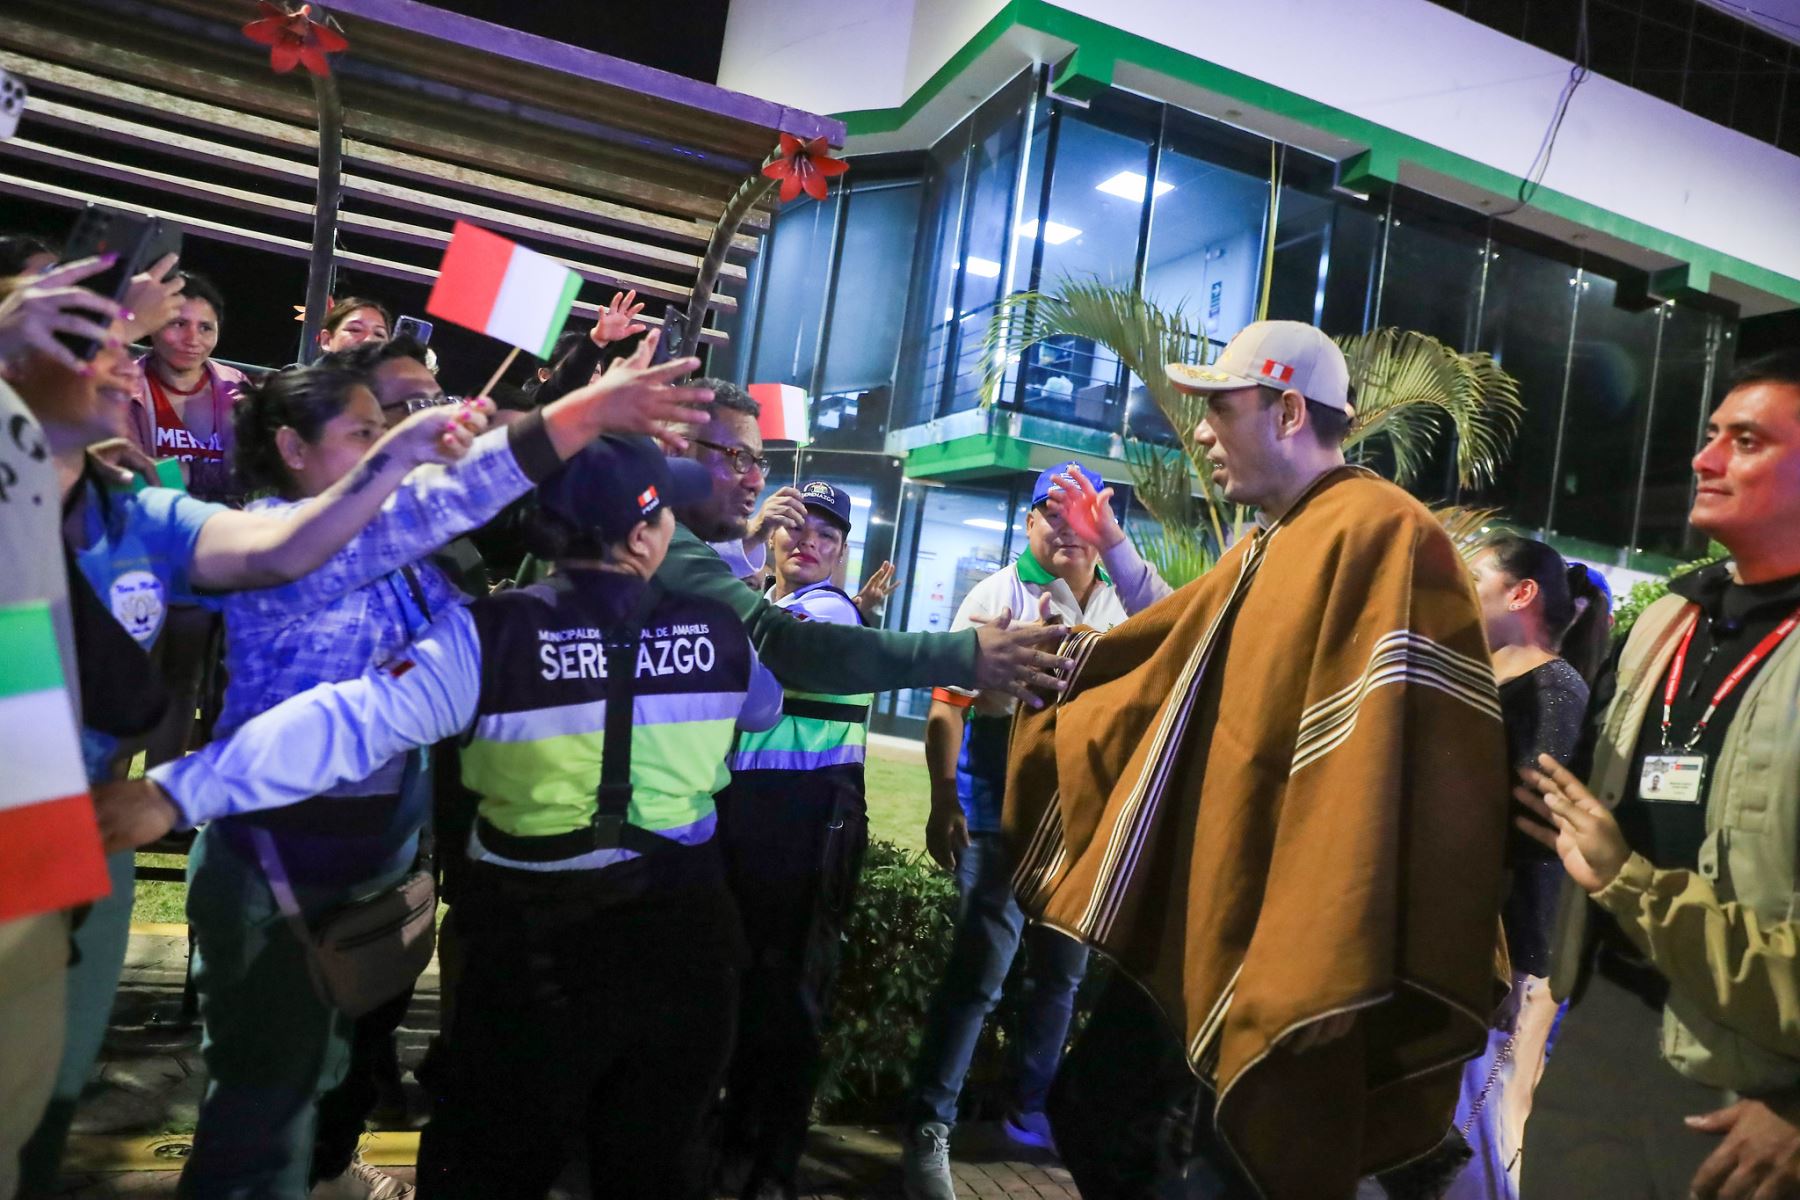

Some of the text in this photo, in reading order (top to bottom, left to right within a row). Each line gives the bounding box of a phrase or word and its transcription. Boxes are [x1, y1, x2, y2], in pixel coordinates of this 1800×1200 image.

[656, 626, 669, 638] DE
[672, 624, 710, 636] AMARILIS
[540, 636, 715, 681] SEREAZGO
